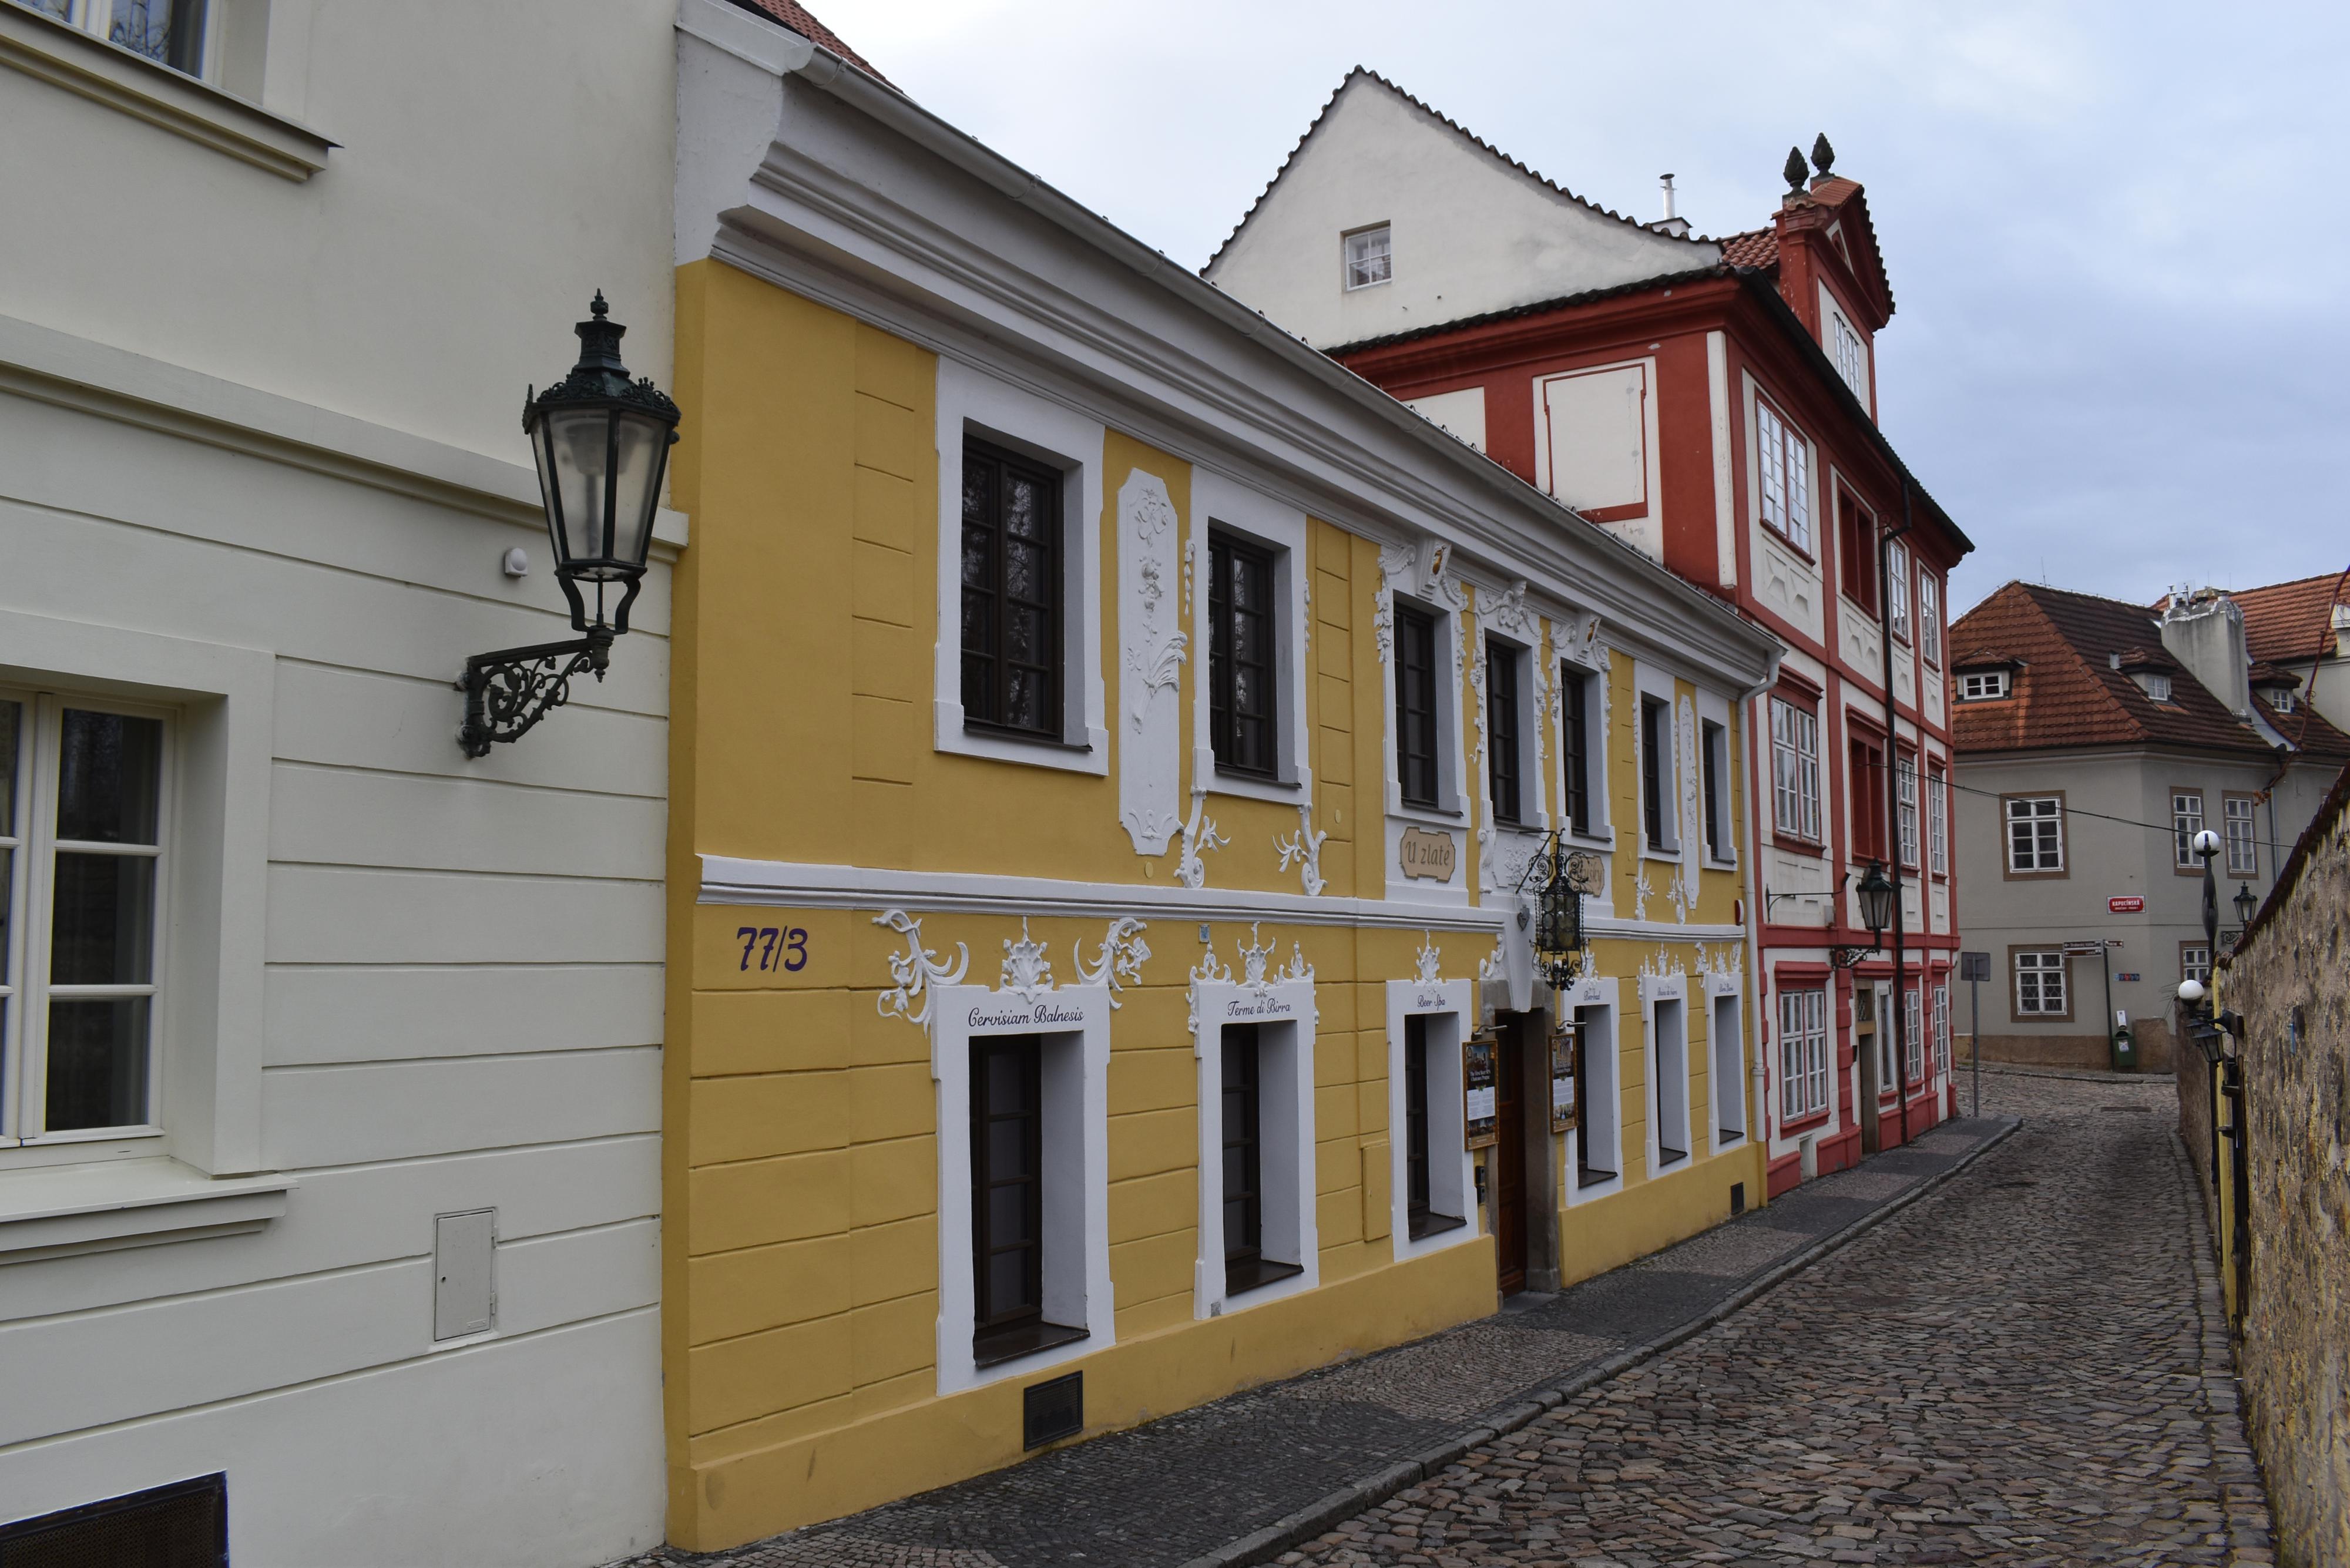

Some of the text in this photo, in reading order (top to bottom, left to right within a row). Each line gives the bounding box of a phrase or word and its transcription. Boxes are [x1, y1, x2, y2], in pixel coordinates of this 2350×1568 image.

[1405, 841, 1450, 866] U zlaté
[736, 925, 808, 973] 77/3
[1227, 997, 1291, 1016] Terme di Birra
[1417, 993, 1445, 1011] Beer Spa
[968, 1004, 1085, 1027] Cervisiam Balnesis
